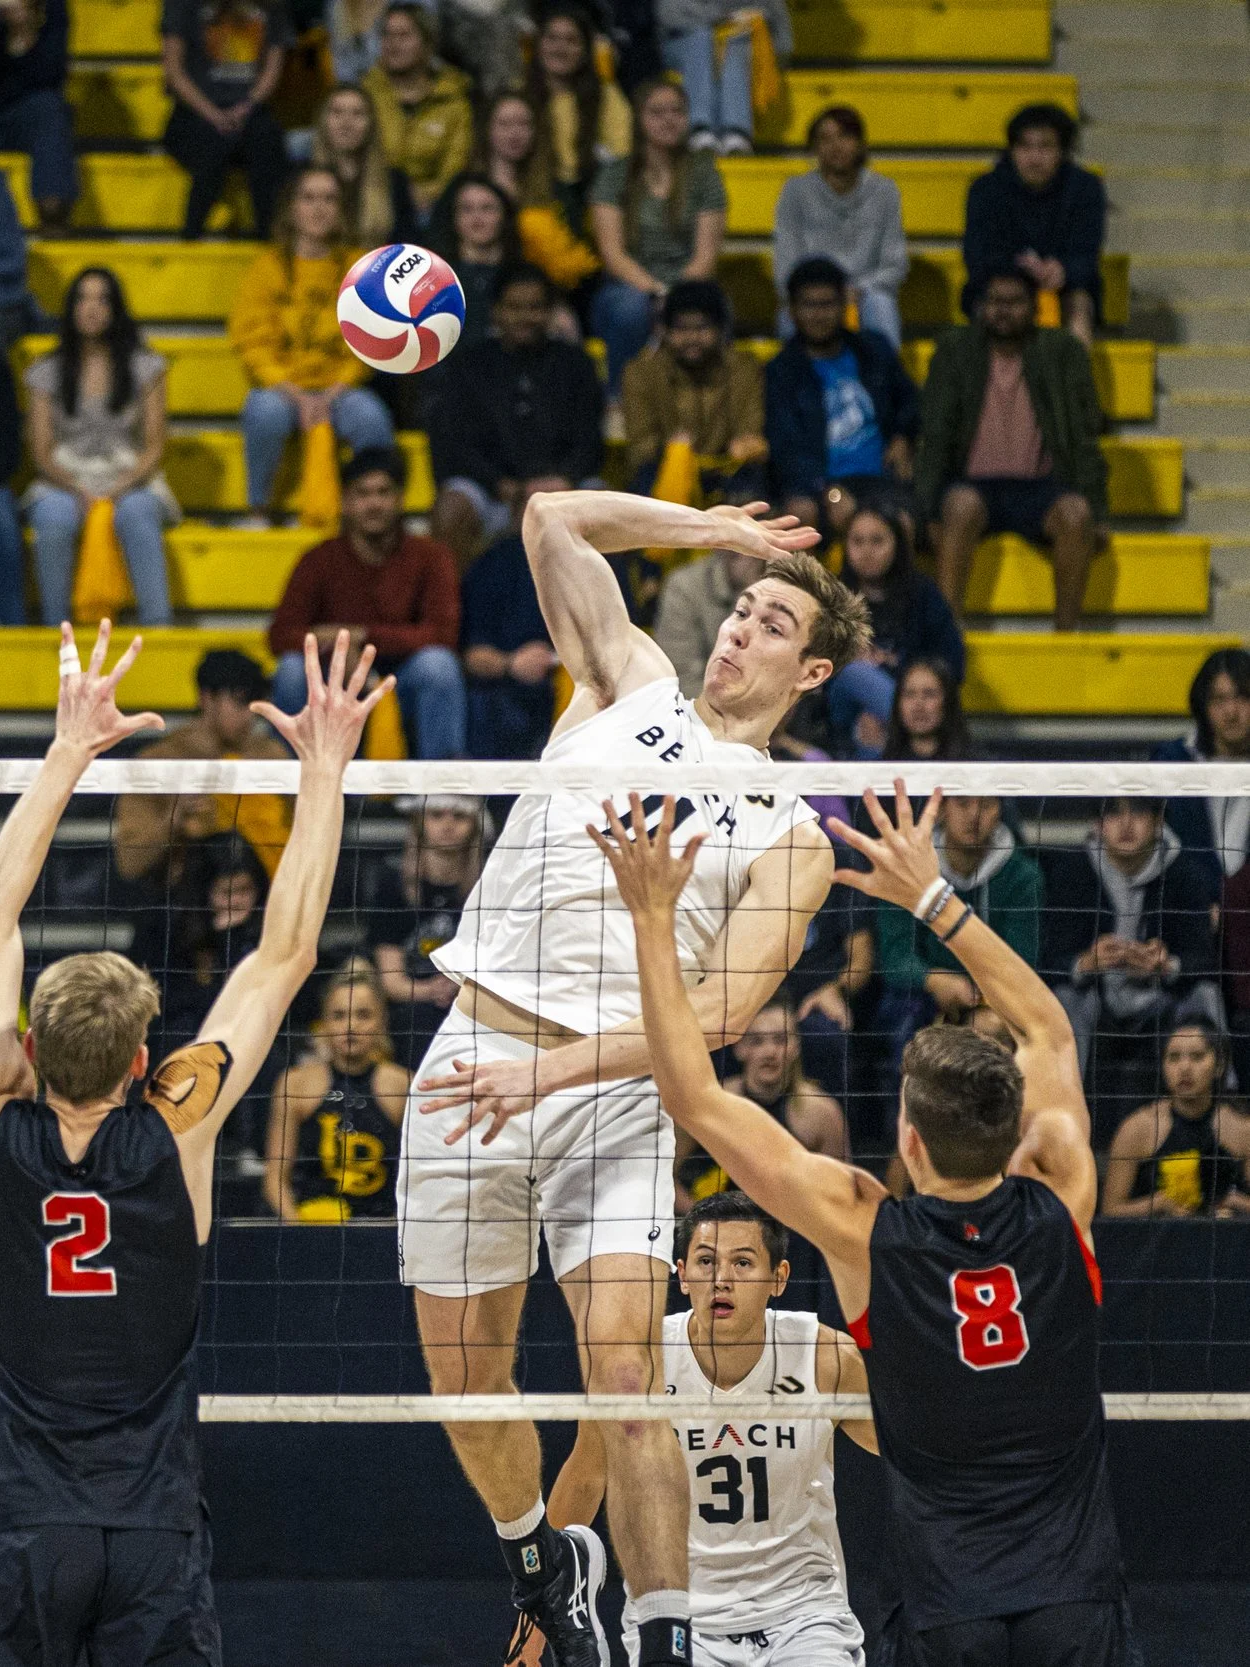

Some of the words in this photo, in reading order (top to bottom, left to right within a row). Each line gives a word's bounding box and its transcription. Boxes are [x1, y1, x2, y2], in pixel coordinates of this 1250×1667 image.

[389, 253, 425, 284] NCAA
[41, 1190, 117, 1296] 2
[949, 1263, 1030, 1371] 8
[672, 1423, 796, 1451] EACH
[695, 1454, 770, 1525] 31
